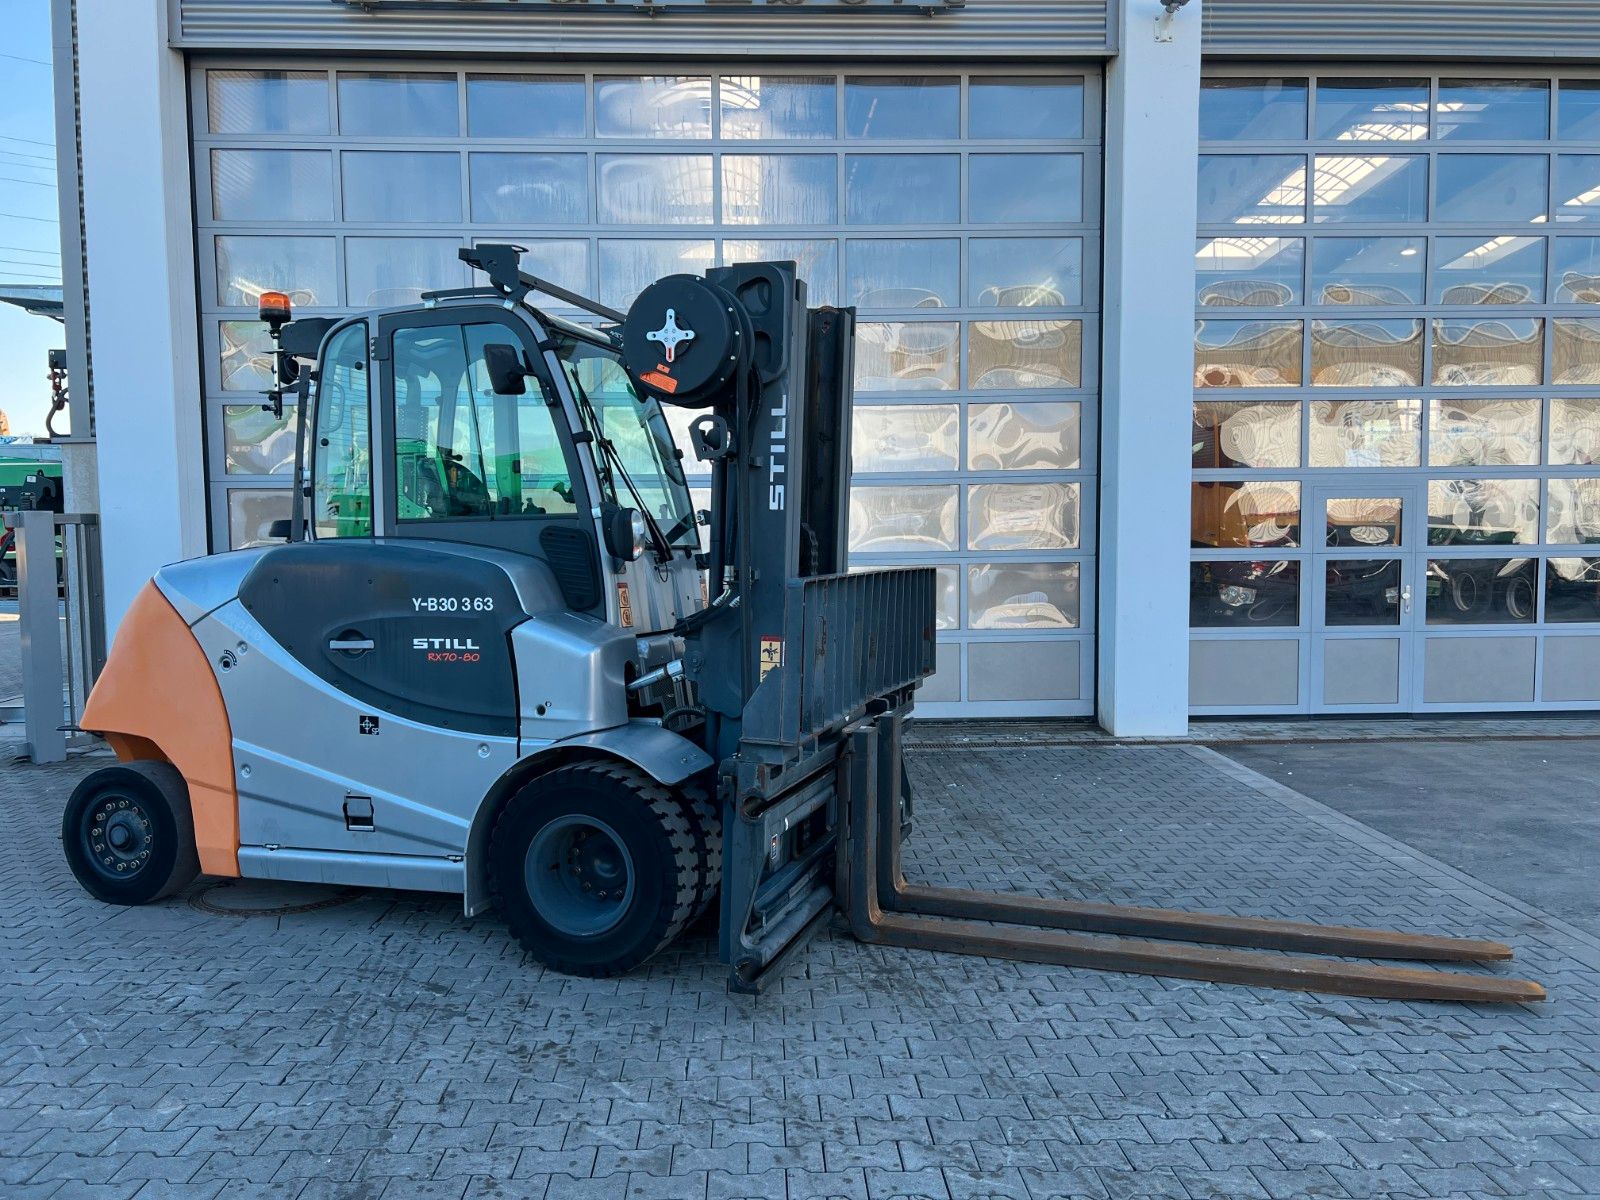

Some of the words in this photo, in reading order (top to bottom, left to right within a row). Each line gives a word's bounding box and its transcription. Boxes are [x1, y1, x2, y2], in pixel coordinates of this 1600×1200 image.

[769, 394, 787, 511] STILL
[412, 638, 480, 650] STILL
[427, 652, 480, 662] RX70-80
